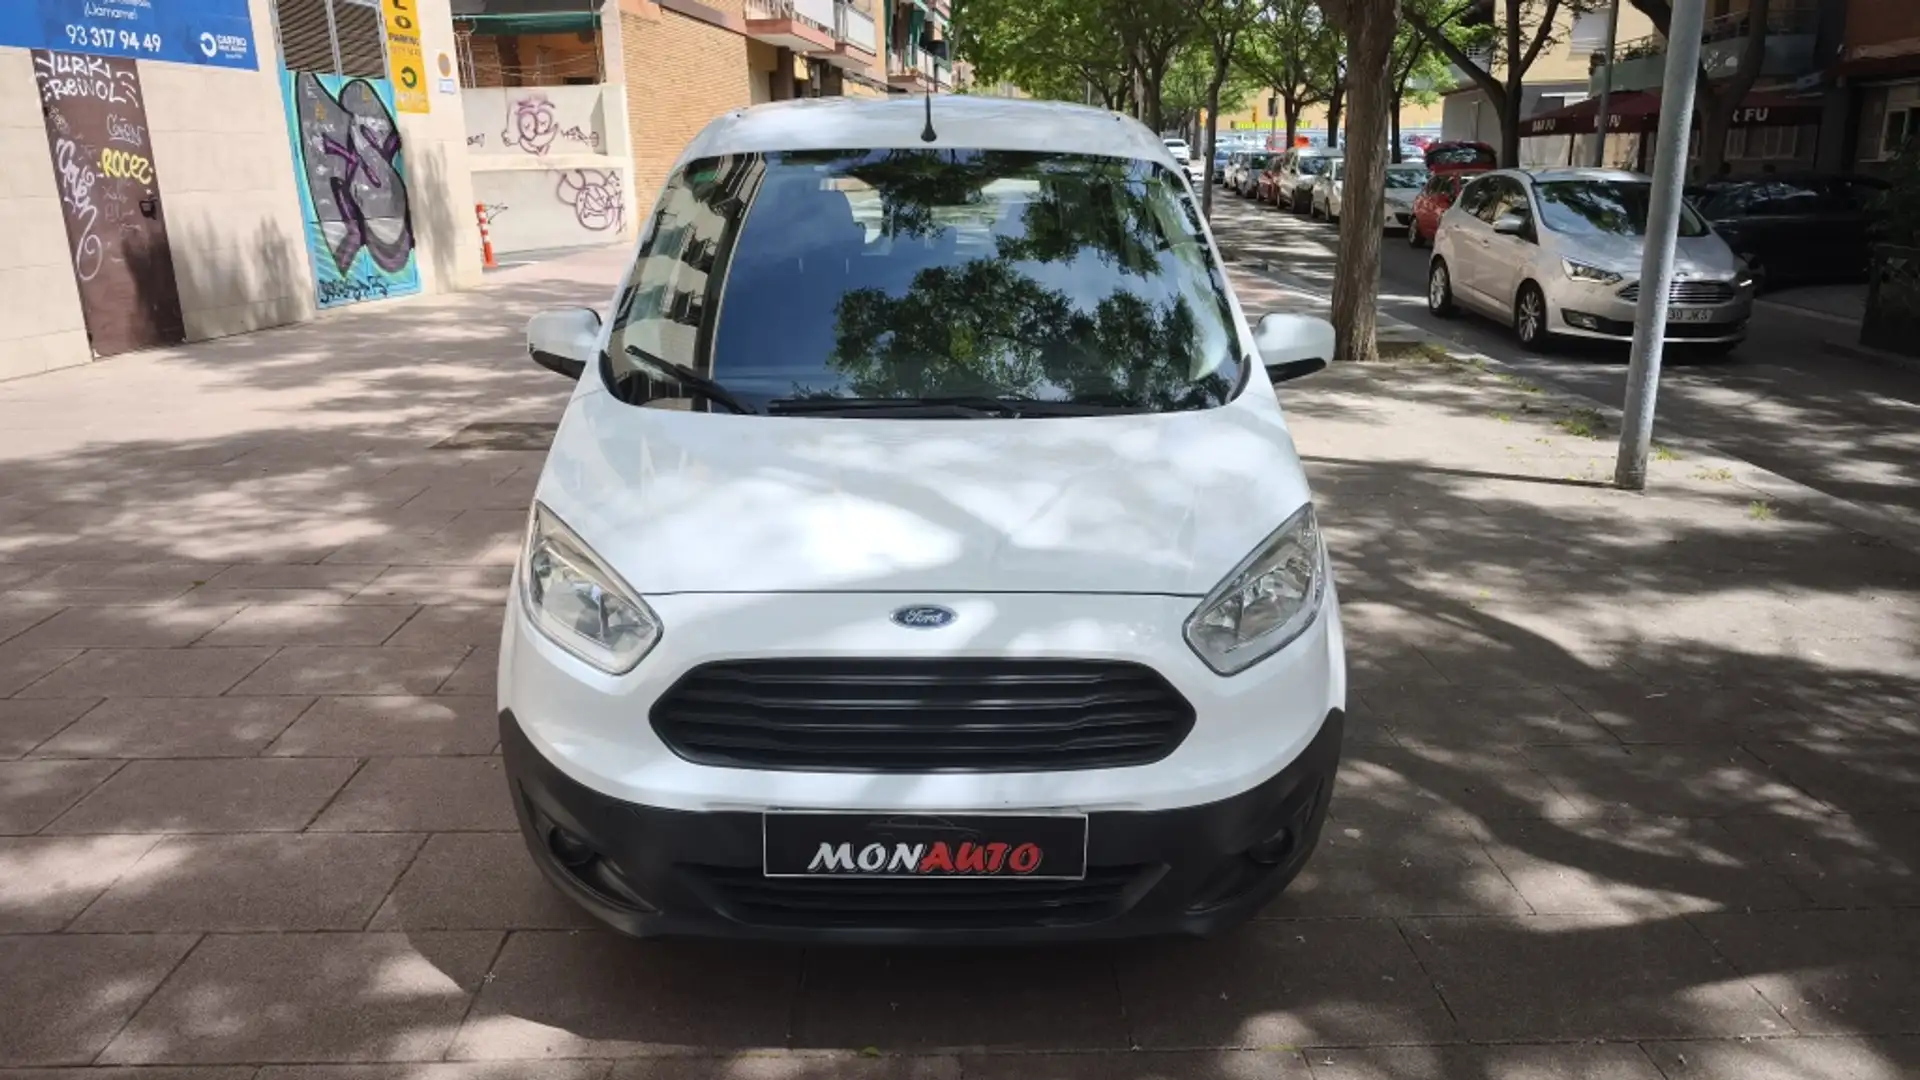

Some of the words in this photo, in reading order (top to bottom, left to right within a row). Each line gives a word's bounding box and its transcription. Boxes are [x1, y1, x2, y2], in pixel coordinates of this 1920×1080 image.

[65, 24, 88, 46] 93
[90, 26, 115, 48] 317
[119, 29, 140, 50] 94
[143, 33, 161, 52] 49
[1744, 107, 1769, 121] FU
[904, 608, 943, 624] Ford
[808, 841, 1042, 874] MONAUTO
